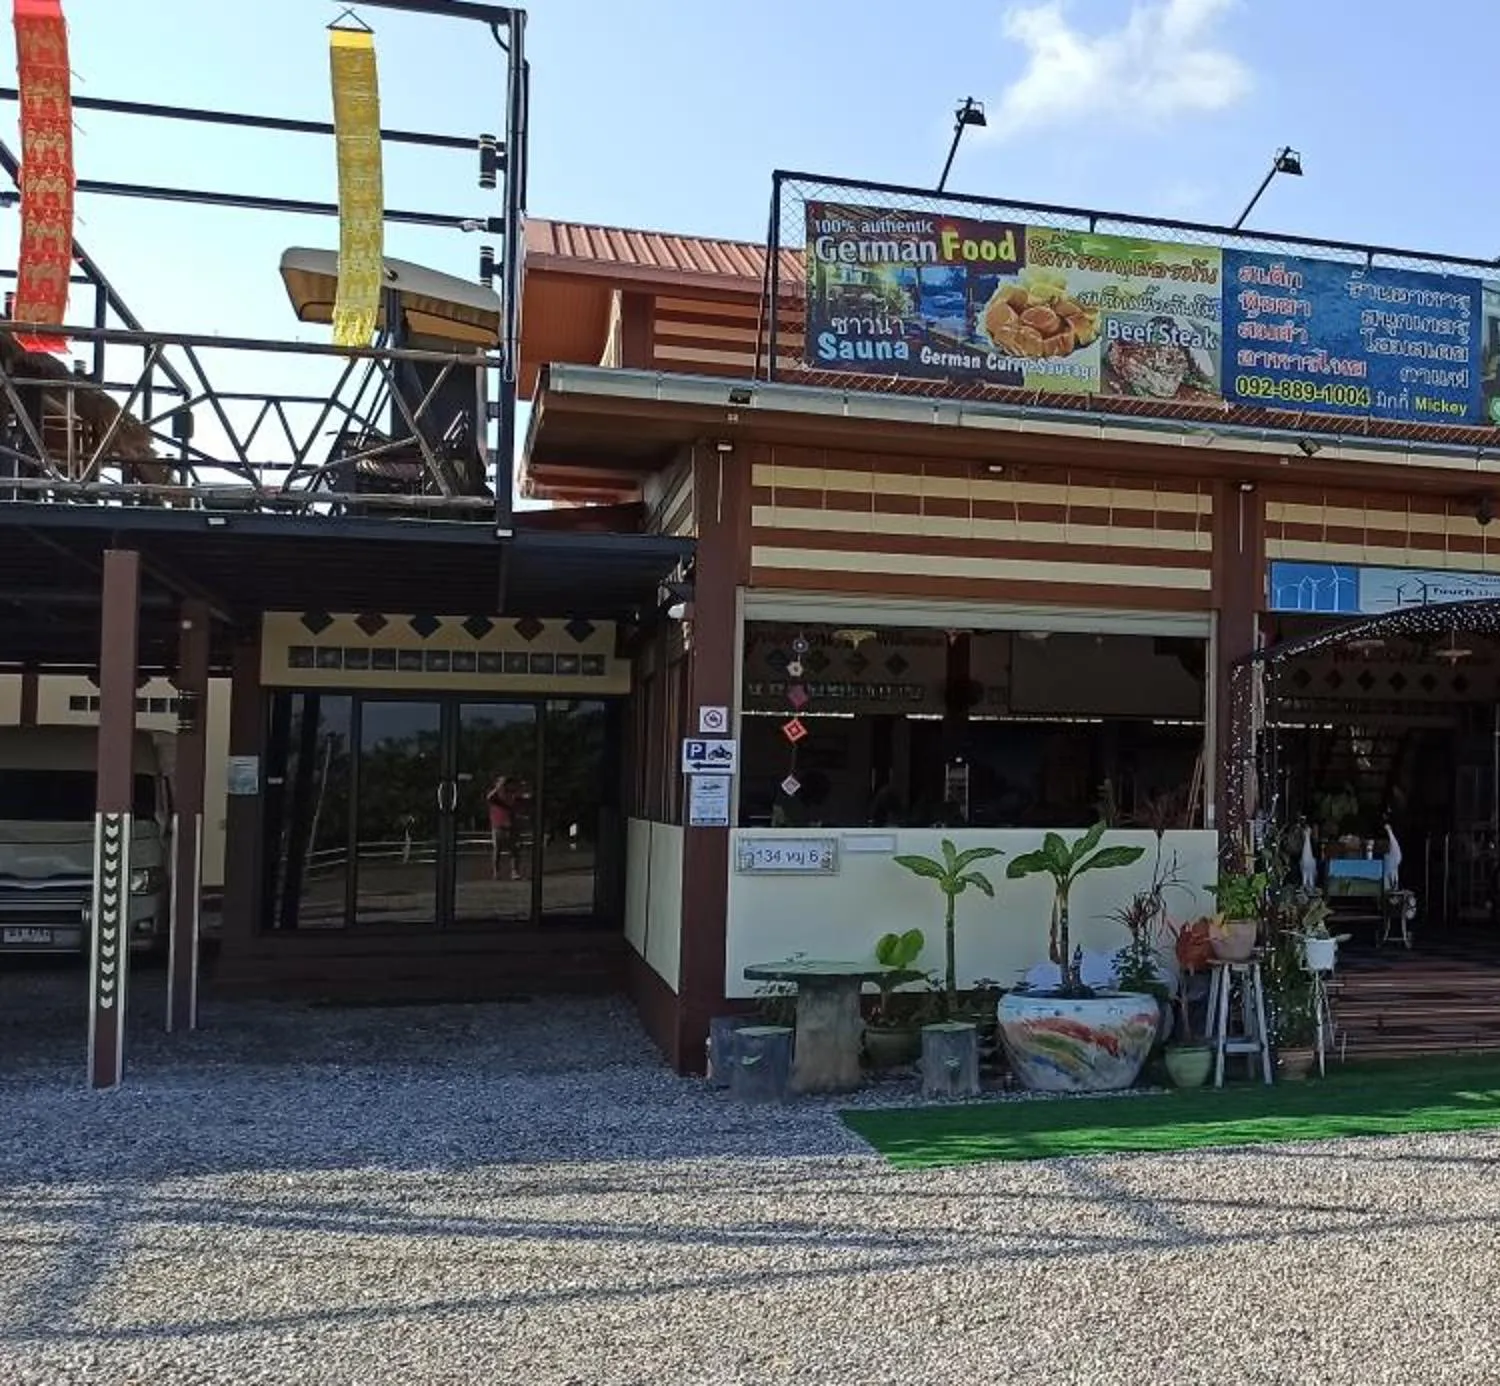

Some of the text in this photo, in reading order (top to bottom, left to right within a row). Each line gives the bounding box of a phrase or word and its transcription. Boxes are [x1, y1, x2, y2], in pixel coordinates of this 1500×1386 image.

[815, 218, 935, 234] 100% authentic
[815, 229, 1017, 263] German Food
[817, 332, 909, 361] Sauna
[1107, 318, 1217, 349] Beef Steak
[920, 346, 981, 369] German
[1235, 375, 1371, 408] 092-889-1004
[1414, 395, 1468, 417] Mickey
[756, 848, 781, 864] 134
[809, 849, 819, 863] 6
